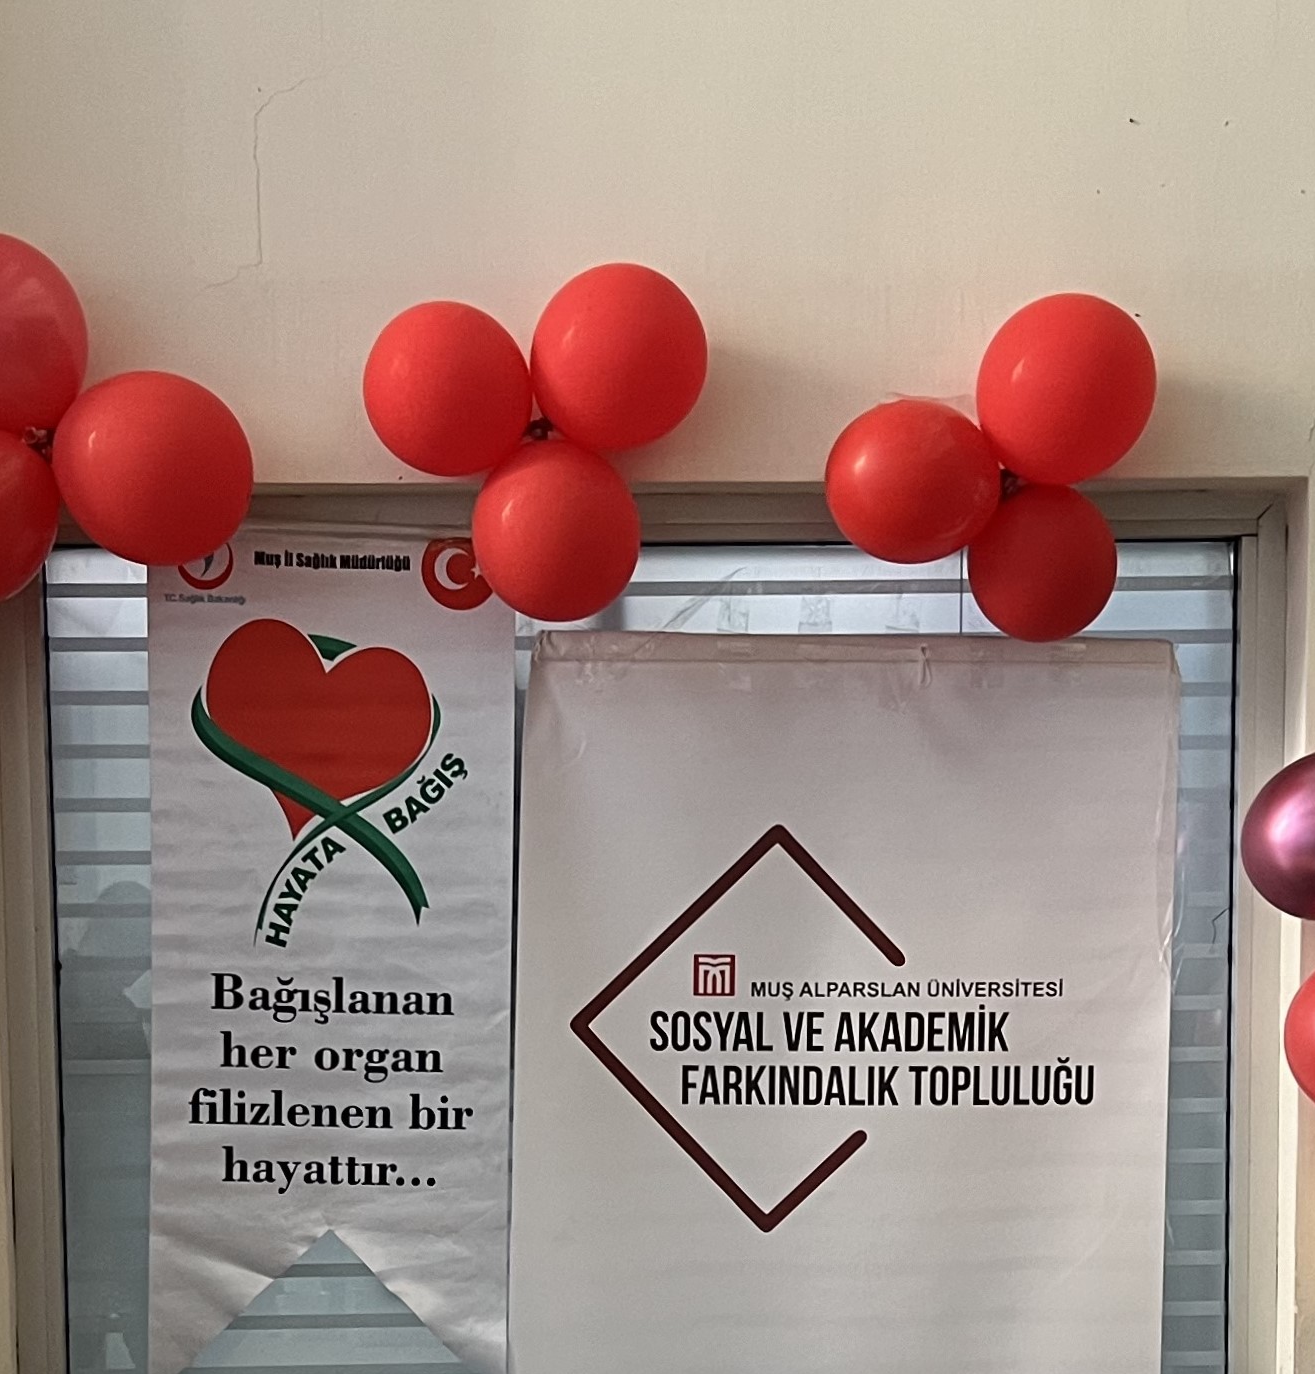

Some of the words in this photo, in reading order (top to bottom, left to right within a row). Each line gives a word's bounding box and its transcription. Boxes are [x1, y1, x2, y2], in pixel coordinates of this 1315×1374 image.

[254, 550, 282, 568] Muş
[296, 552, 337, 570] Sağlık
[339, 555, 411, 572] Müdürlüğü
[265, 836, 346, 948] HAYATA
[383, 753, 469, 835] BAĞIŞ
[210, 972, 455, 1025] Bağışlanan
[750, 980, 794, 1001] MUŞ
[798, 981, 921, 998] ALPARSLAN
[926, 977, 1065, 999] ÜNİVERSİTESİ
[649, 1009, 774, 1053] SOSYAL
[783, 1010, 825, 1053] VE
[834, 1002, 1010, 1053] AKADEMİK
[220, 1030, 298, 1070] her
[314, 1047, 445, 1084] organ
[681, 1063, 901, 1106] FARKINDALIK
[908, 1056, 1096, 1107] TOPLULUĞU
[187, 1087, 394, 1130] filizlenen
[408, 1093, 474, 1130] bir
[221, 1145, 437, 1195] hayattır...
